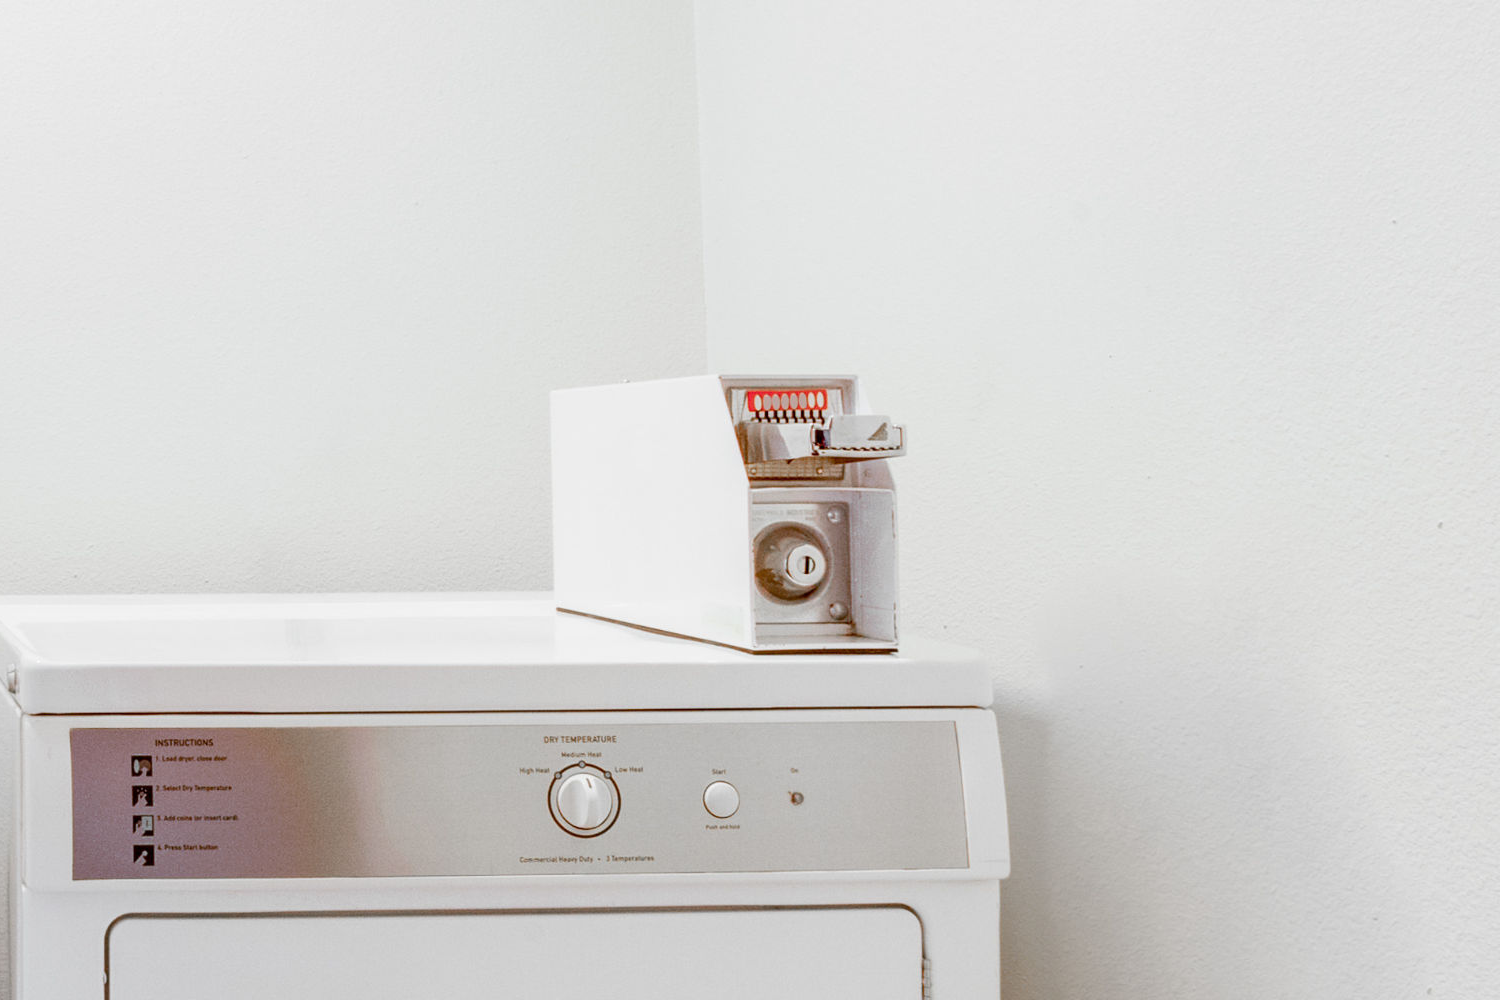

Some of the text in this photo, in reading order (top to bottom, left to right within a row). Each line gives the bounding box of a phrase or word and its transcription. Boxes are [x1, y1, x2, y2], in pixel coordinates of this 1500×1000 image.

[155, 739, 214, 747] INSTRUCTIONS
[544, 736, 617, 744] DRY TEMPERATURE
[559, 856, 578, 864] Heavy
[579, 856, 593, 864] Duty
[612, 855, 654, 863] Temperatures
